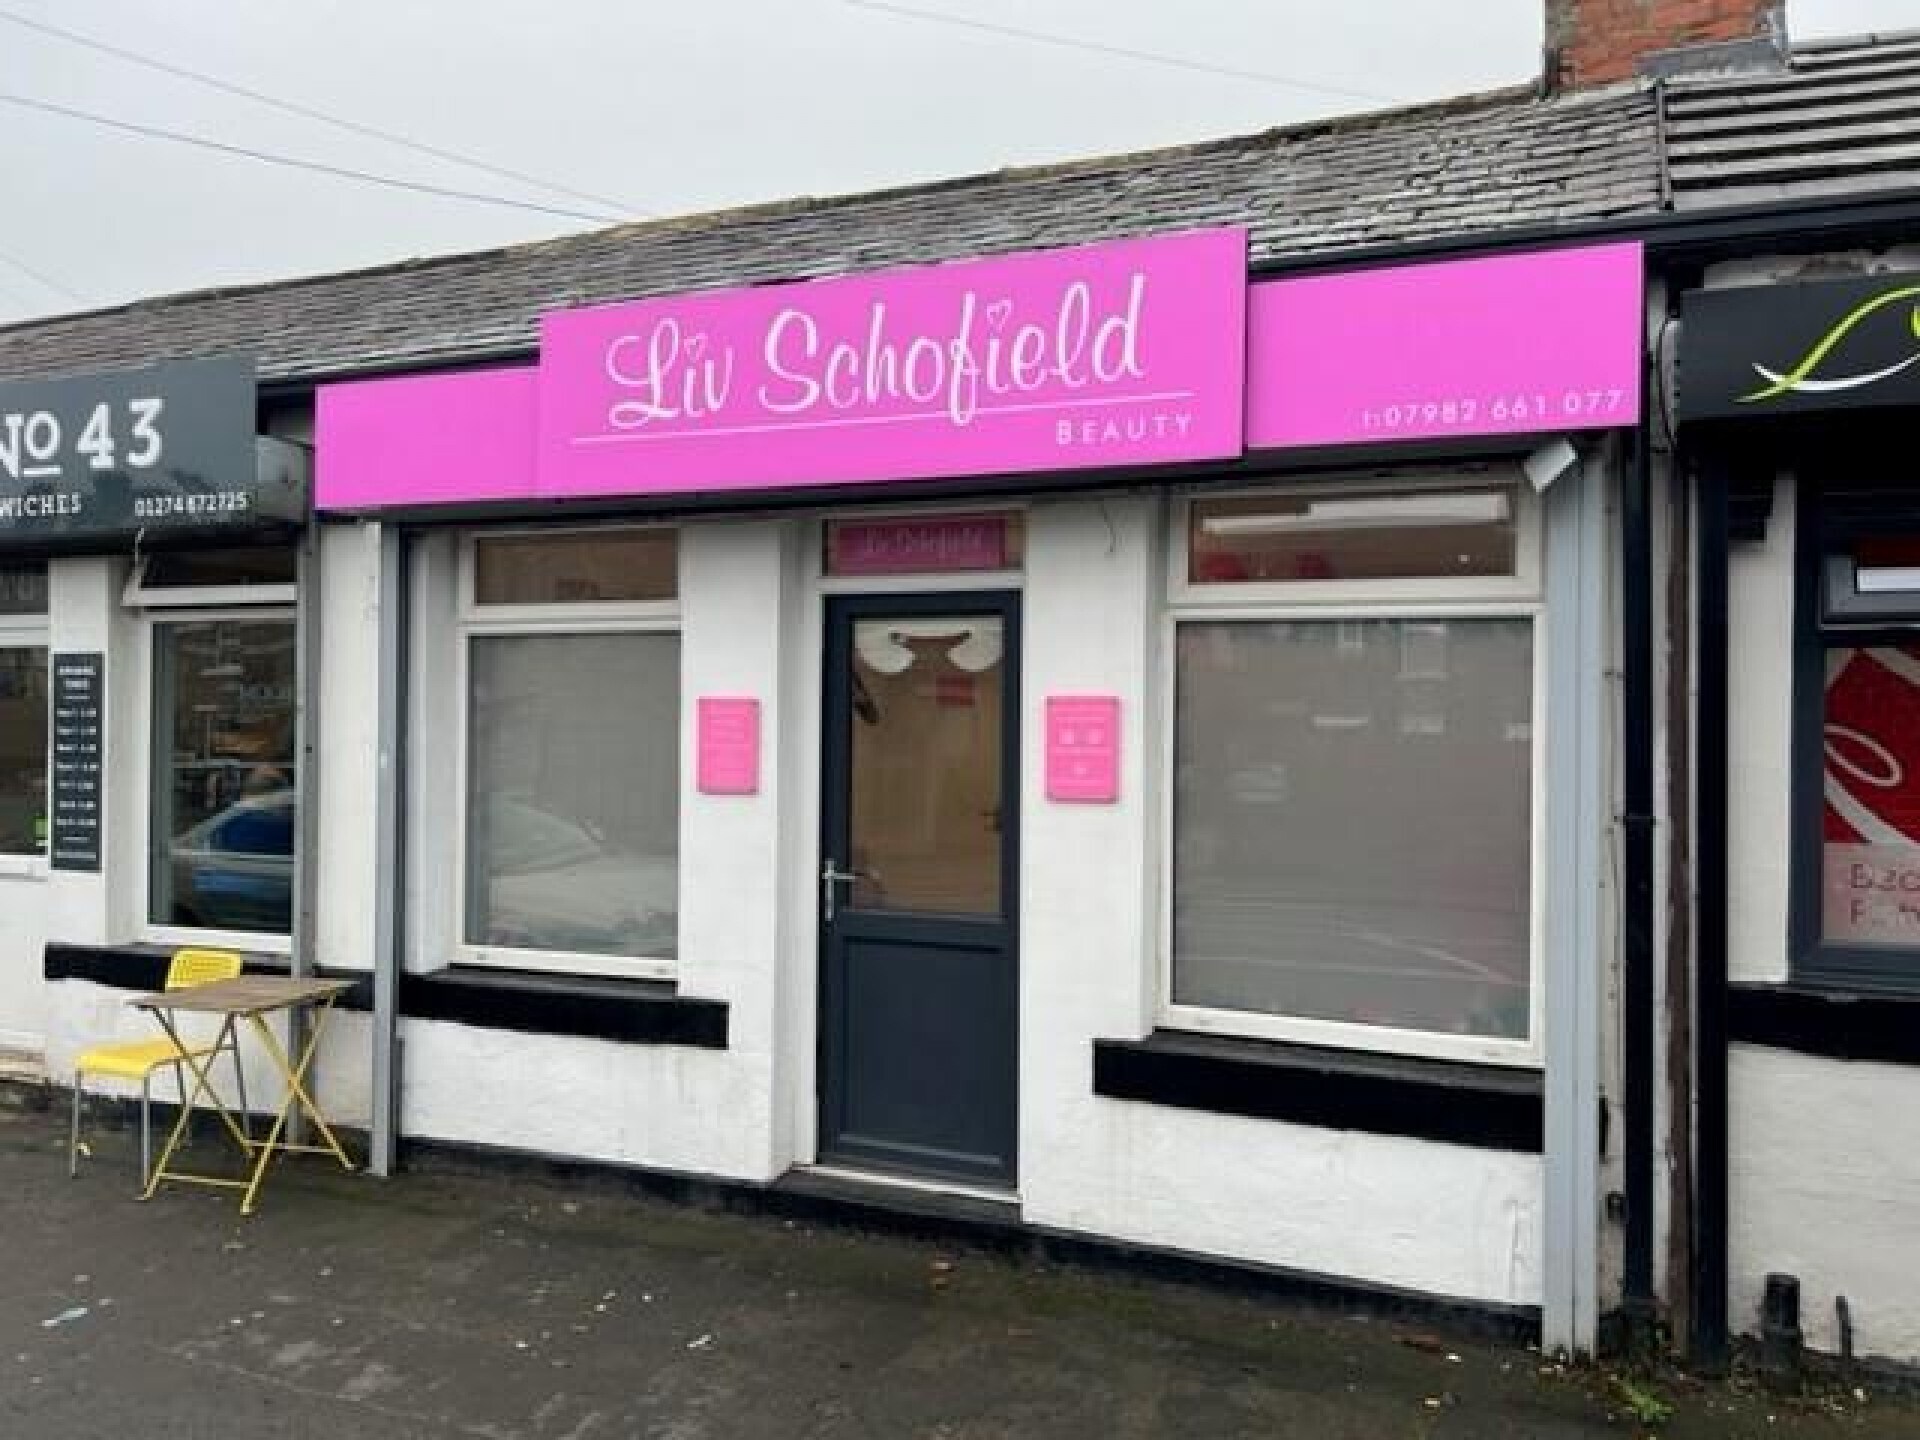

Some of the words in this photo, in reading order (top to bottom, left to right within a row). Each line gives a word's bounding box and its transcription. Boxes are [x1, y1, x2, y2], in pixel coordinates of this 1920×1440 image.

[605, 316, 733, 430] Liv
[757, 272, 1146, 425] Schofield
[1056, 413, 1193, 446] BEAUTY
[1492, 393, 1547, 421] 661
[1562, 388, 1624, 416] 077
[77, 398, 163, 468] 43
